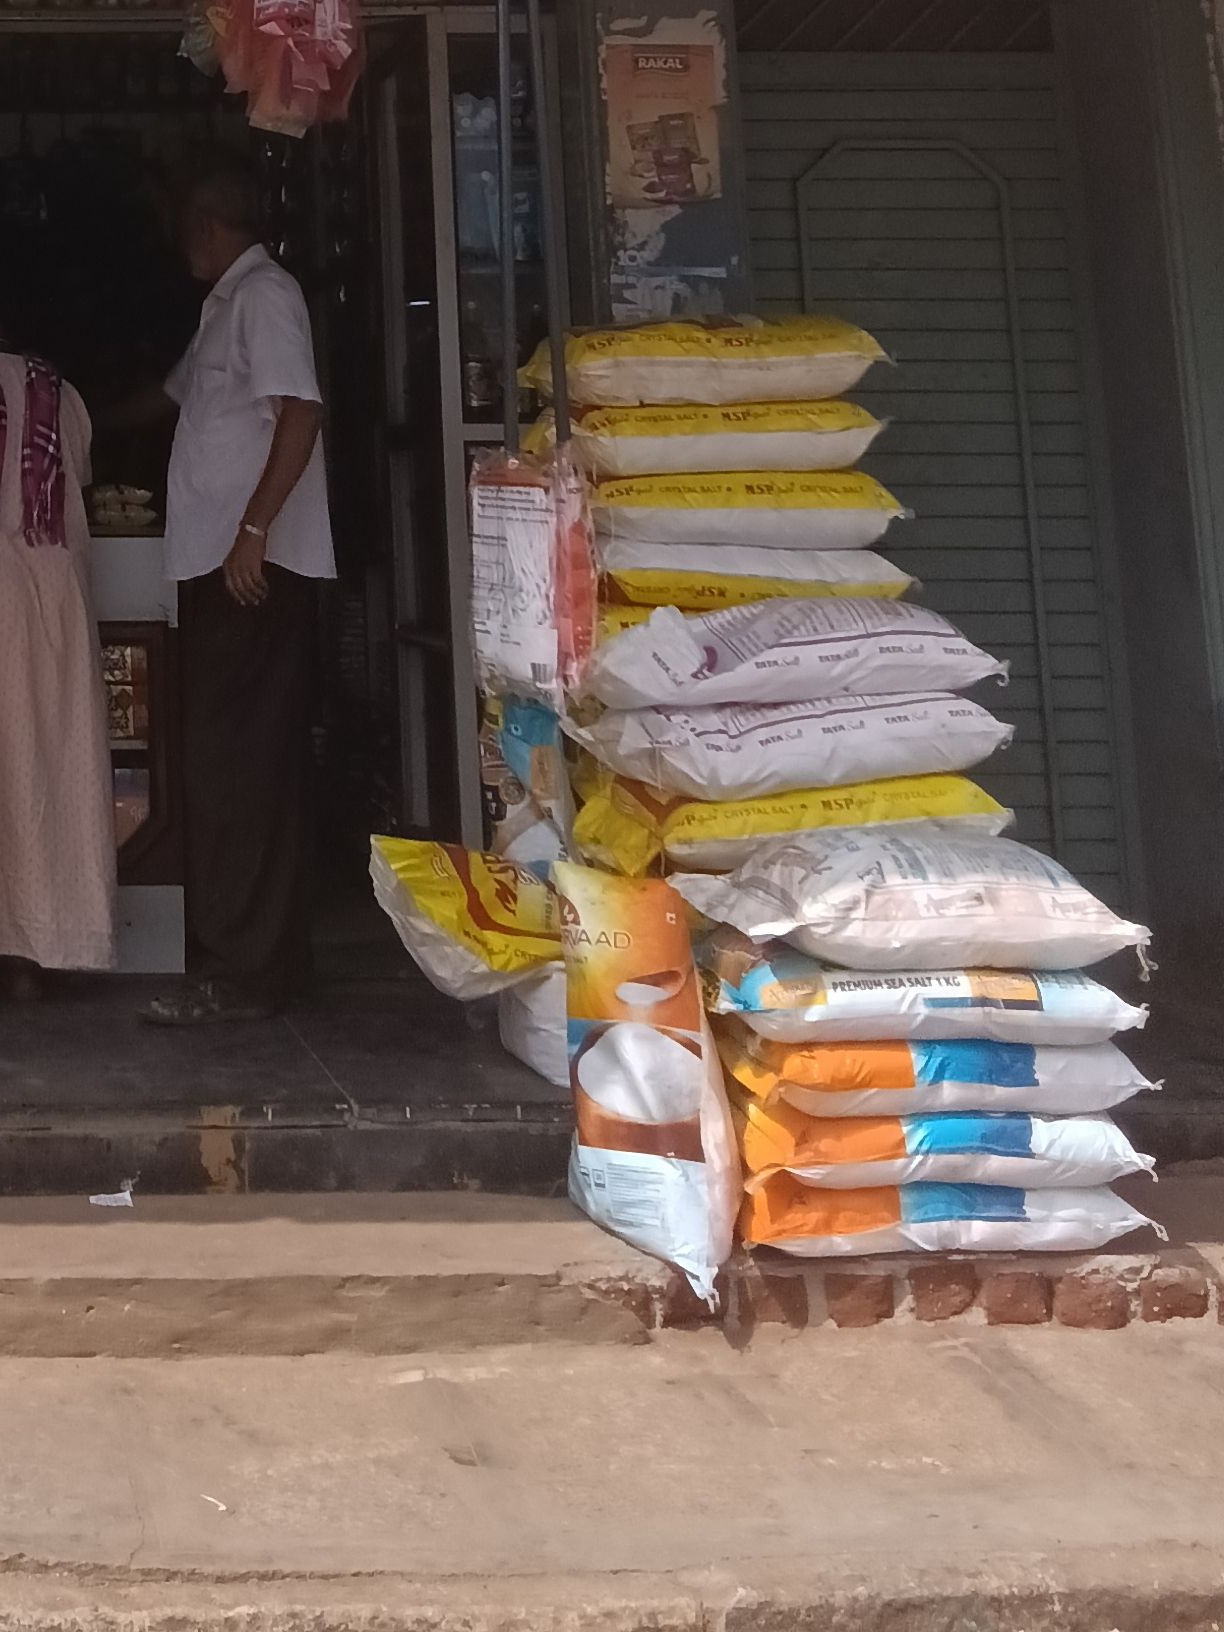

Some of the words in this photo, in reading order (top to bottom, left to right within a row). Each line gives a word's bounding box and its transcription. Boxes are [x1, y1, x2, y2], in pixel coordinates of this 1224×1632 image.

[638, 56, 683, 70] RAKAL
[754, 658, 780, 669] TATA
[878, 643, 904, 652] TATA
[758, 733, 784, 745] TATA
[884, 713, 909, 723] TATA
[948, 707, 974, 716] TATA
[722, 803, 769, 820] CRYSTAL
[561, 928, 632, 950] RVAAD
[831, 976, 884, 993] PREMIUM
[884, 976, 907, 990] SEA
[907, 974, 933, 989] SALT
[944, 974, 962, 988] KG
